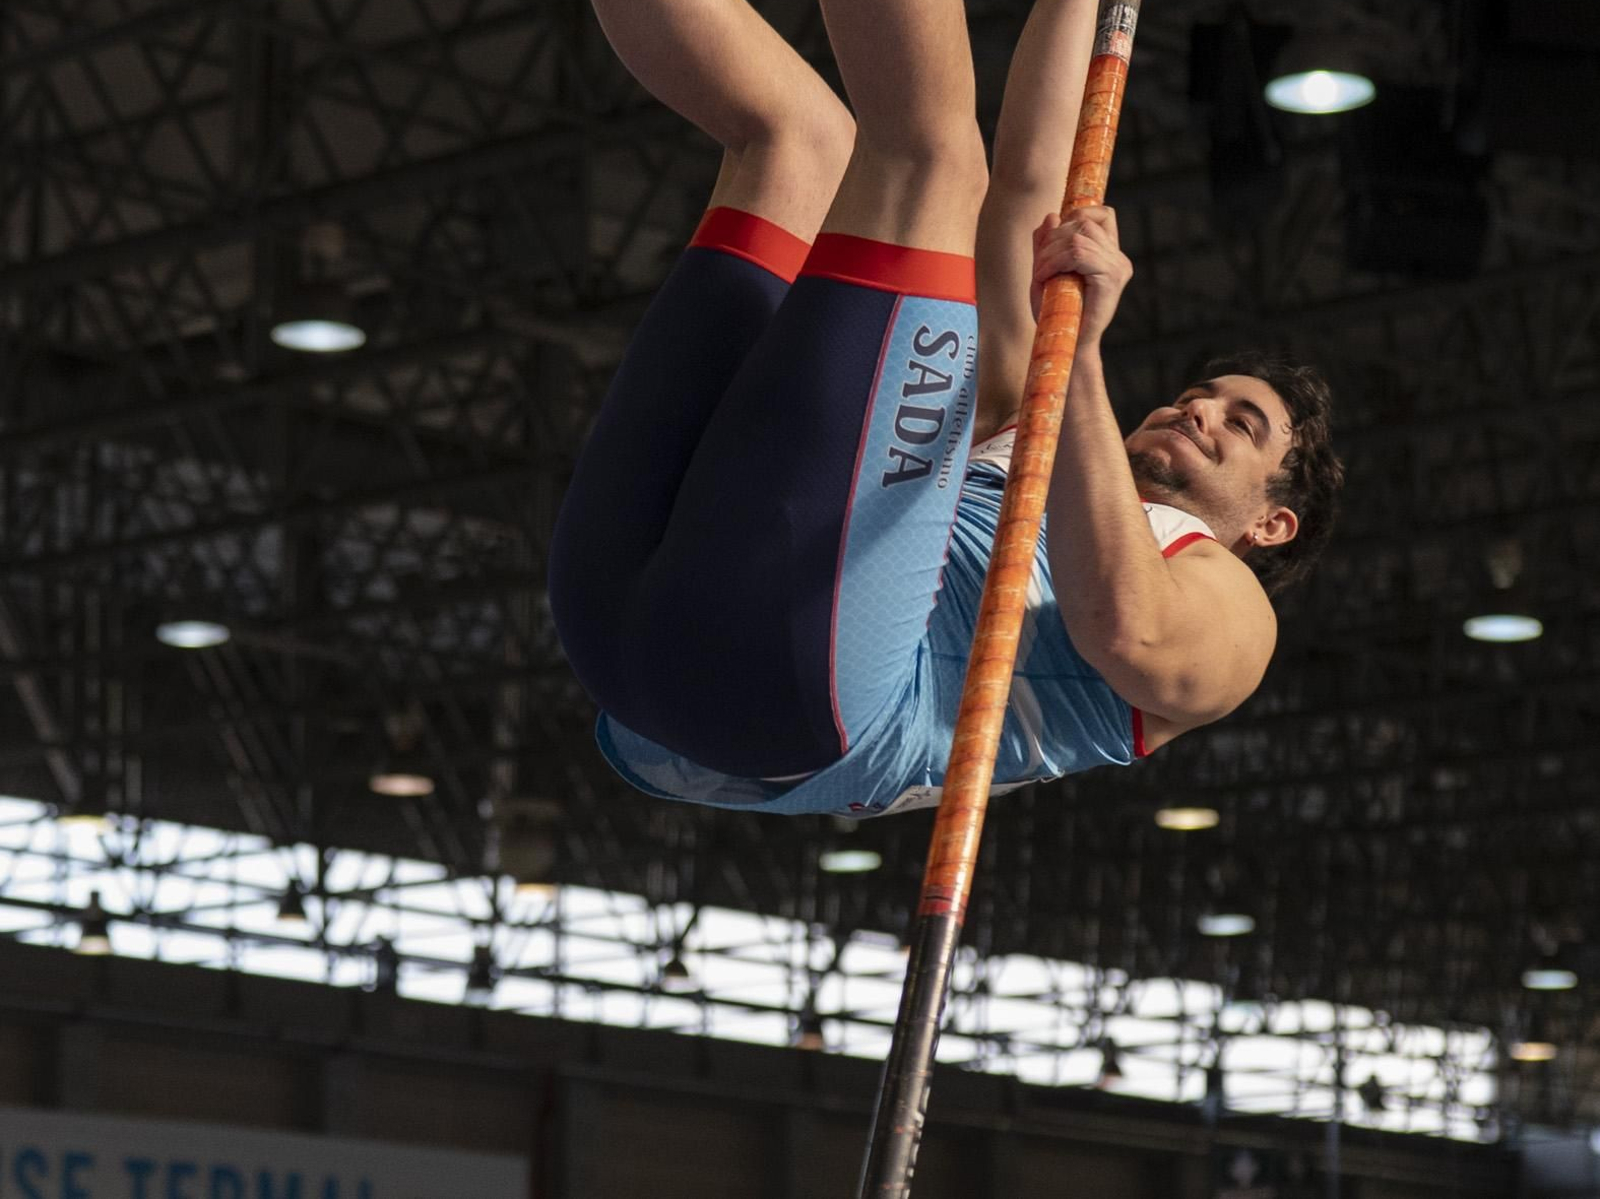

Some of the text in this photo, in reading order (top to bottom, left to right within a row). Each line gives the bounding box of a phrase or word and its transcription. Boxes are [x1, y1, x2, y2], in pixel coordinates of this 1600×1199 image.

[882, 325, 960, 488] SADA
[938, 335, 976, 489] club atletismo
